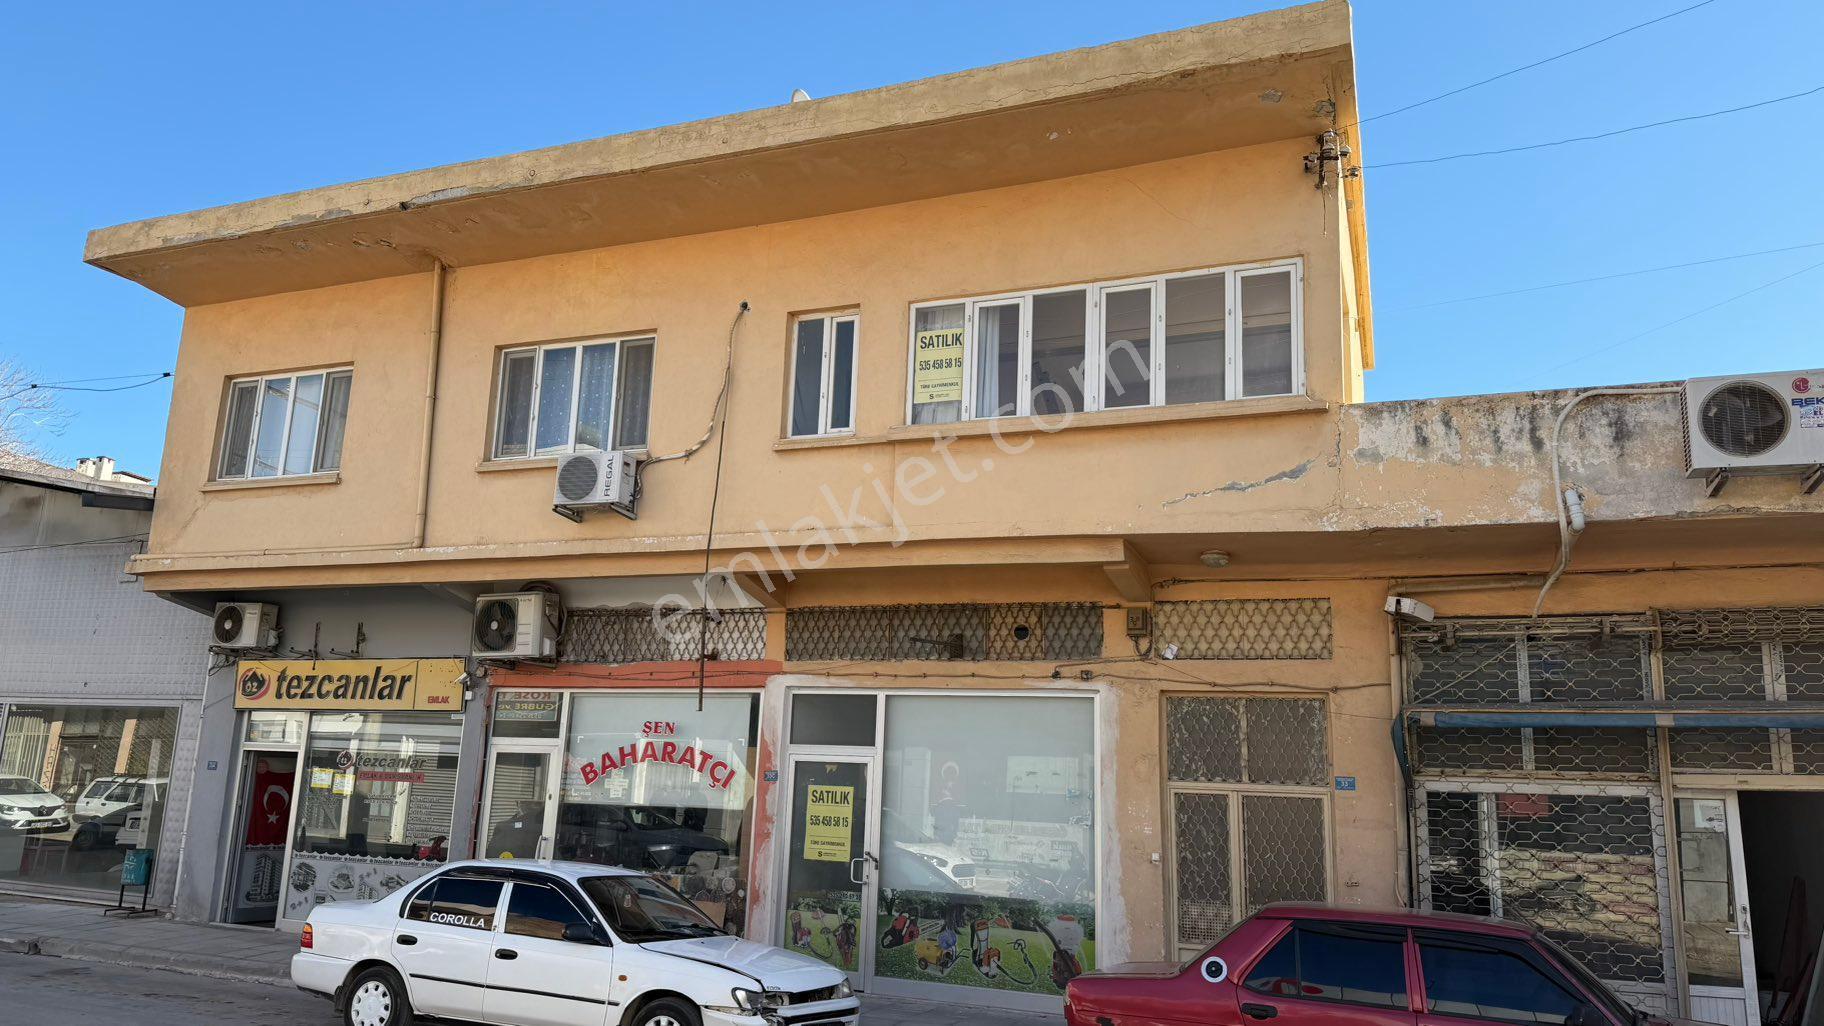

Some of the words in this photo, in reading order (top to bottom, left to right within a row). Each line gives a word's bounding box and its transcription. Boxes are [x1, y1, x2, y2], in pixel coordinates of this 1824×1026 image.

[920, 333, 962, 349] SATILIK
[919, 360, 930, 371] 535
[932, 359, 944, 370] 458
[945, 358, 952, 369] 58
[954, 357, 962, 368] 15
[604, 455, 614, 497] REGAL
[275, 664, 413, 700] tezcanlar
[427, 696, 450, 704] EMLAK
[642, 721, 676, 737] ŞEN
[358, 755, 427, 769] tezcanlar
[580, 741, 736, 789] BAHARATÇI
[811, 789, 850, 805] SATILIK
[810, 815, 820, 826] 535
[821, 815, 832, 827] 458
[833, 816, 840, 827] 58
[842, 817, 849, 828] 15
[430, 912, 485, 928] COROLLA
